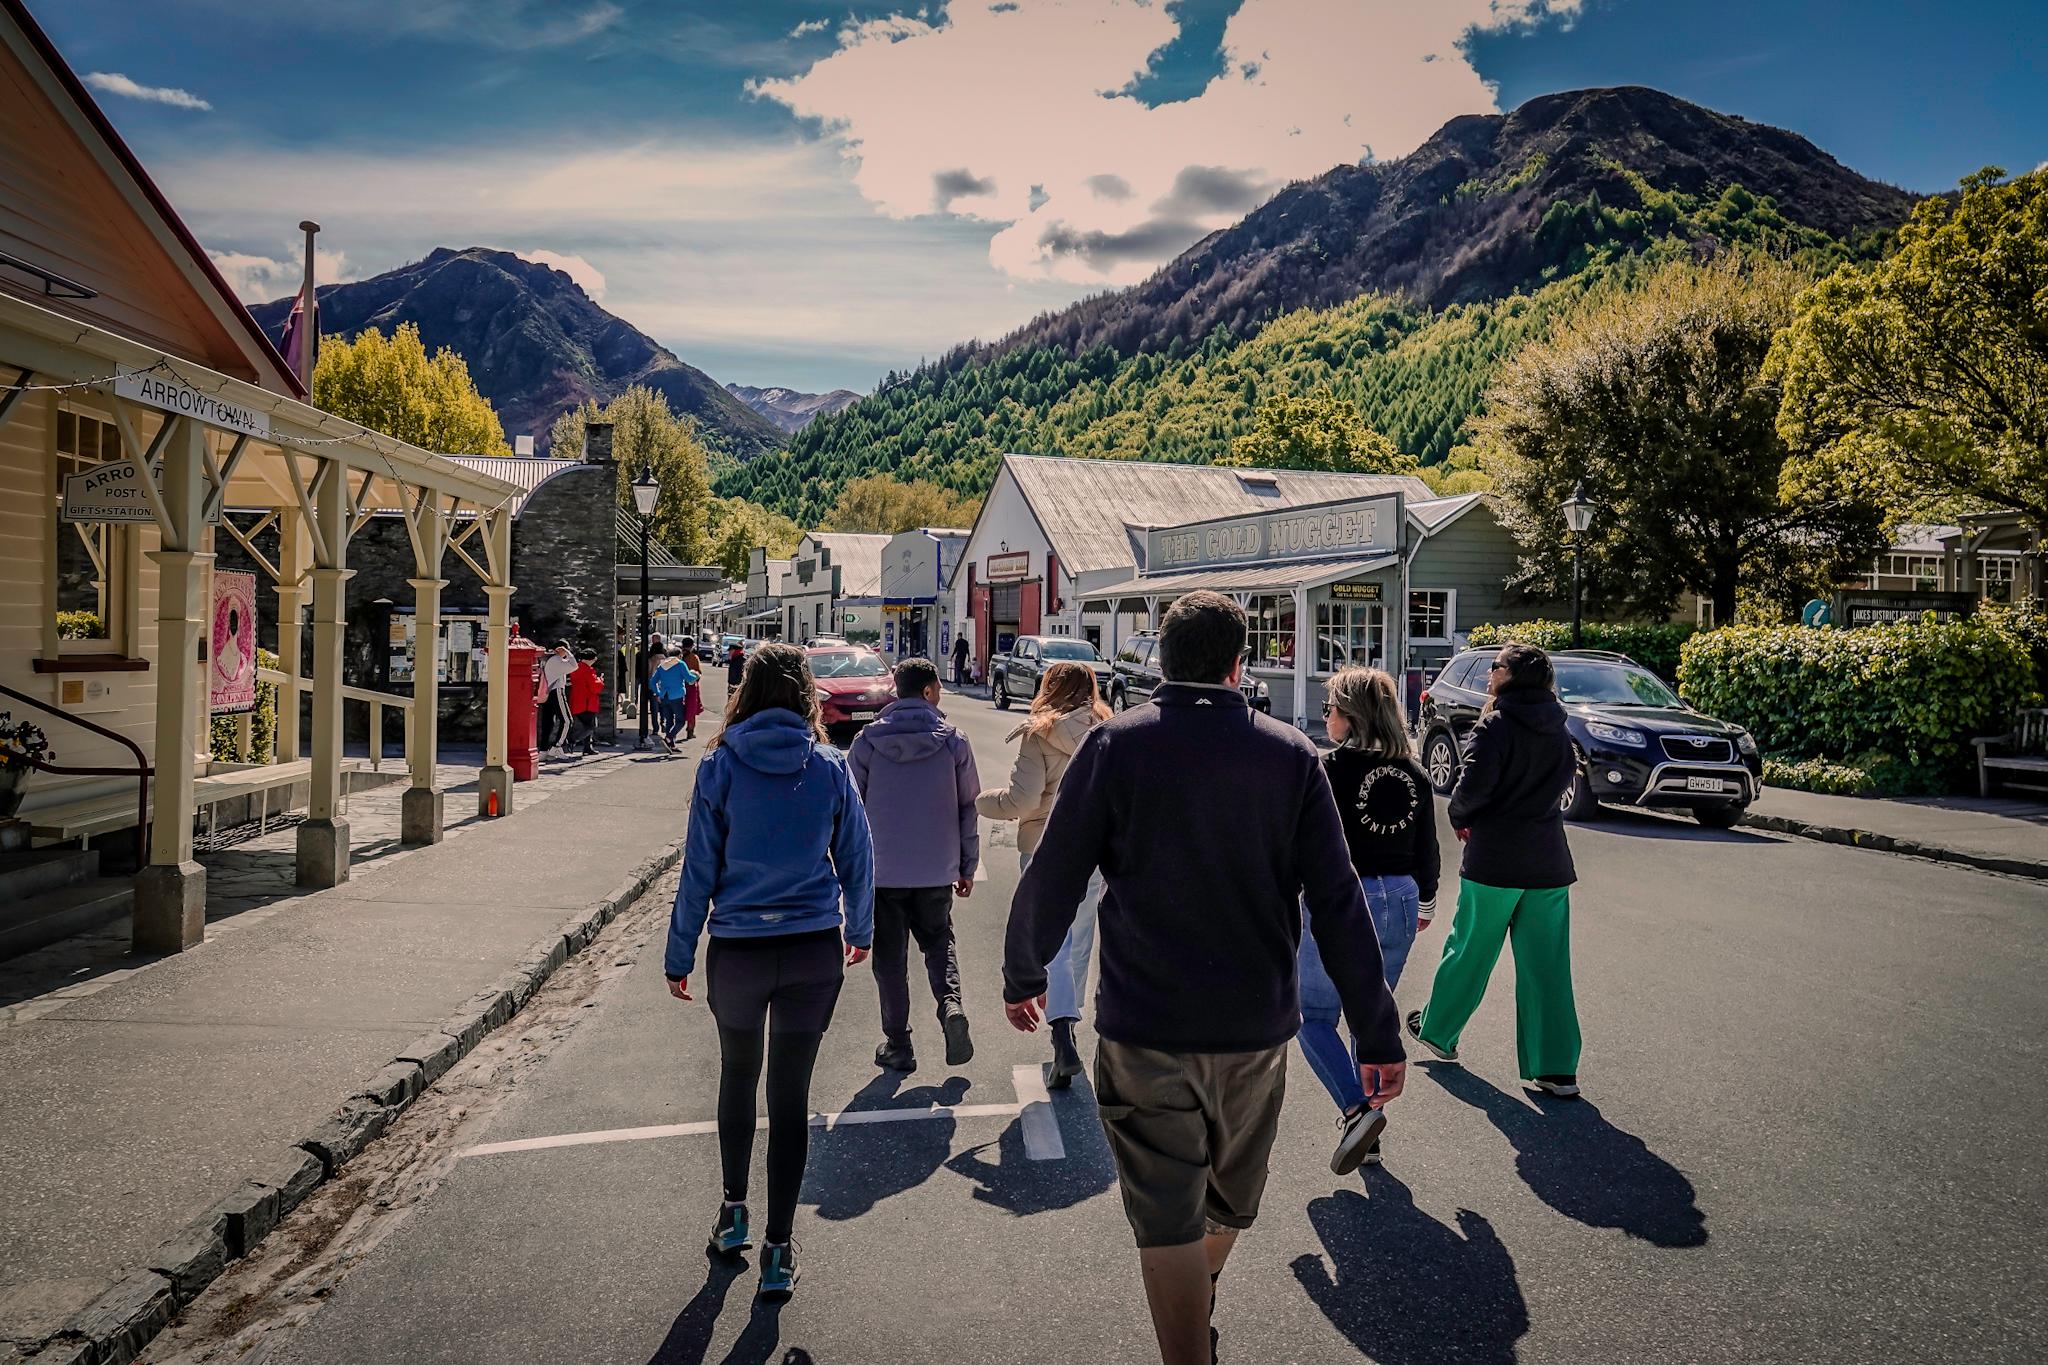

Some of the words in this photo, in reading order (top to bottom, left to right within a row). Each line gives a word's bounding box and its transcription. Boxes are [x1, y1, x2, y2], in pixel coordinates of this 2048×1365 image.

[140, 378, 253, 431] ARROWTOWN
[105, 488, 137, 498] POST
[70, 506, 101, 515] GIFTS
[1161, 532, 1199, 564] THE
[1205, 523, 1262, 560] GOLD
[1268, 507, 1378, 552] NUGGET
[1333, 584, 1351, 593] GOLD
[1352, 585, 1379, 594] NUGGET
[1852, 609, 1871, 620] LAKES
[1872, 610, 1899, 621] DISTRICT
